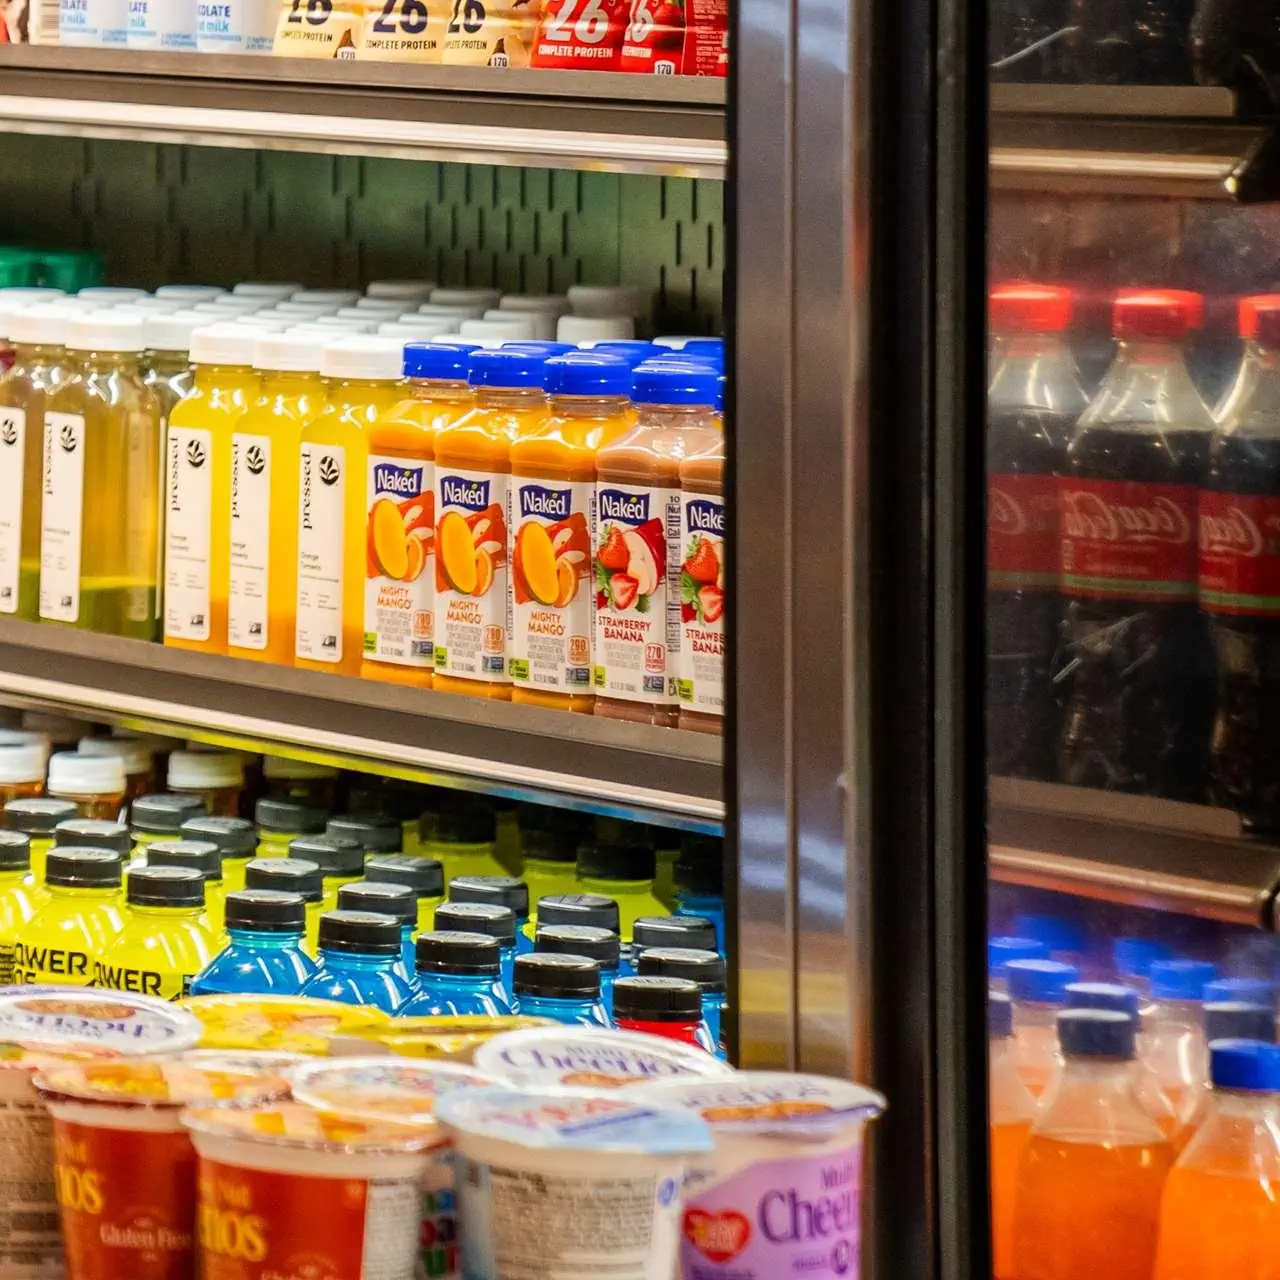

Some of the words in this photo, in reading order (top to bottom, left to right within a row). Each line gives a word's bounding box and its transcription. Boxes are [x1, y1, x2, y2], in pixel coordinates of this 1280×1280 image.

[303, 31, 333, 42] PROTEIN
[400, 40, 437, 51] PROTEIN
[443, 40, 461, 51] MPLETE
[461, 40, 488, 51] PROTEIN
[573, 46, 614, 59] PROTEIN
[493, 57, 508, 68] 170
[656, 63, 673, 75] 170
[169, 436, 181, 512] pressed
[376, 468, 417, 494] Naked
[301, 452, 313, 530] pressed
[443, 481, 485, 507] Naked
[523, 490, 566, 515] Naked
[601, 494, 646, 520] Naked
[689, 505, 725, 531] Nake
[379, 585, 409, 598] MIGHTY
[376, 596, 412, 610] MANGO
[449, 599, 480, 613] MIGHTY
[446, 611, 482, 625] MANGO
[530, 611, 561, 624] MIGHTY
[598, 616, 652, 633] STRAWBERRY
[527, 621, 565, 636] MANGO
[603, 626, 644, 643] BANANA
[685, 627, 725, 644] STRAWBE
[569, 638, 587, 652] 290
[692, 641, 725, 656] BANAN
[647, 646, 662, 660] 270
[14, 941, 88, 976] OWER
[93, 961, 162, 997] OWER
[756, 1187, 858, 1244] Cheer
[99, 1223, 156, 1249] Gluten
